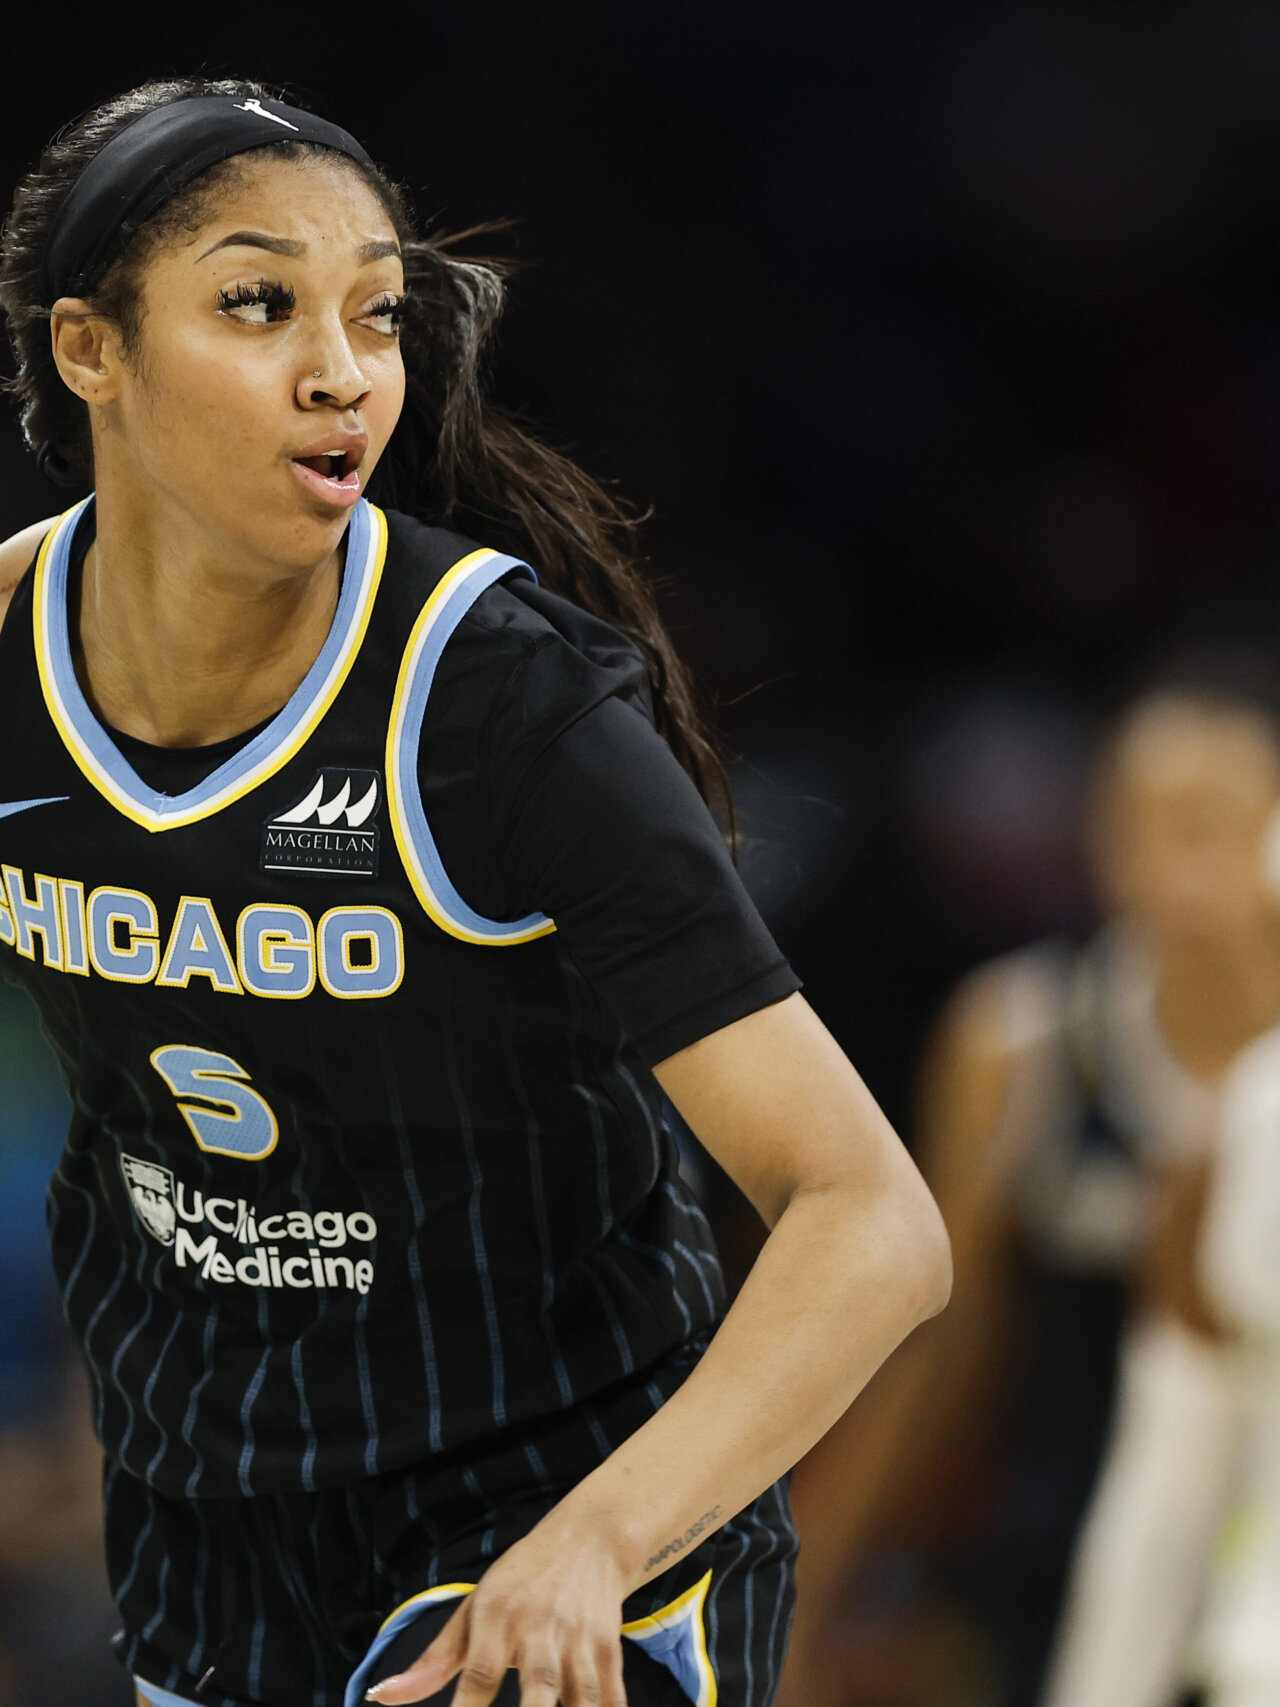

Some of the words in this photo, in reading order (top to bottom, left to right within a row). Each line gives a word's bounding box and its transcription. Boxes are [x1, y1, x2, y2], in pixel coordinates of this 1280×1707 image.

[264, 854, 374, 867] CORPORATION
[266, 832, 375, 852] MAGELLAN
[150, 1044, 279, 1160] 5
[176, 1181, 378, 1249] UChicago
[174, 1227, 375, 1295] Medicine
